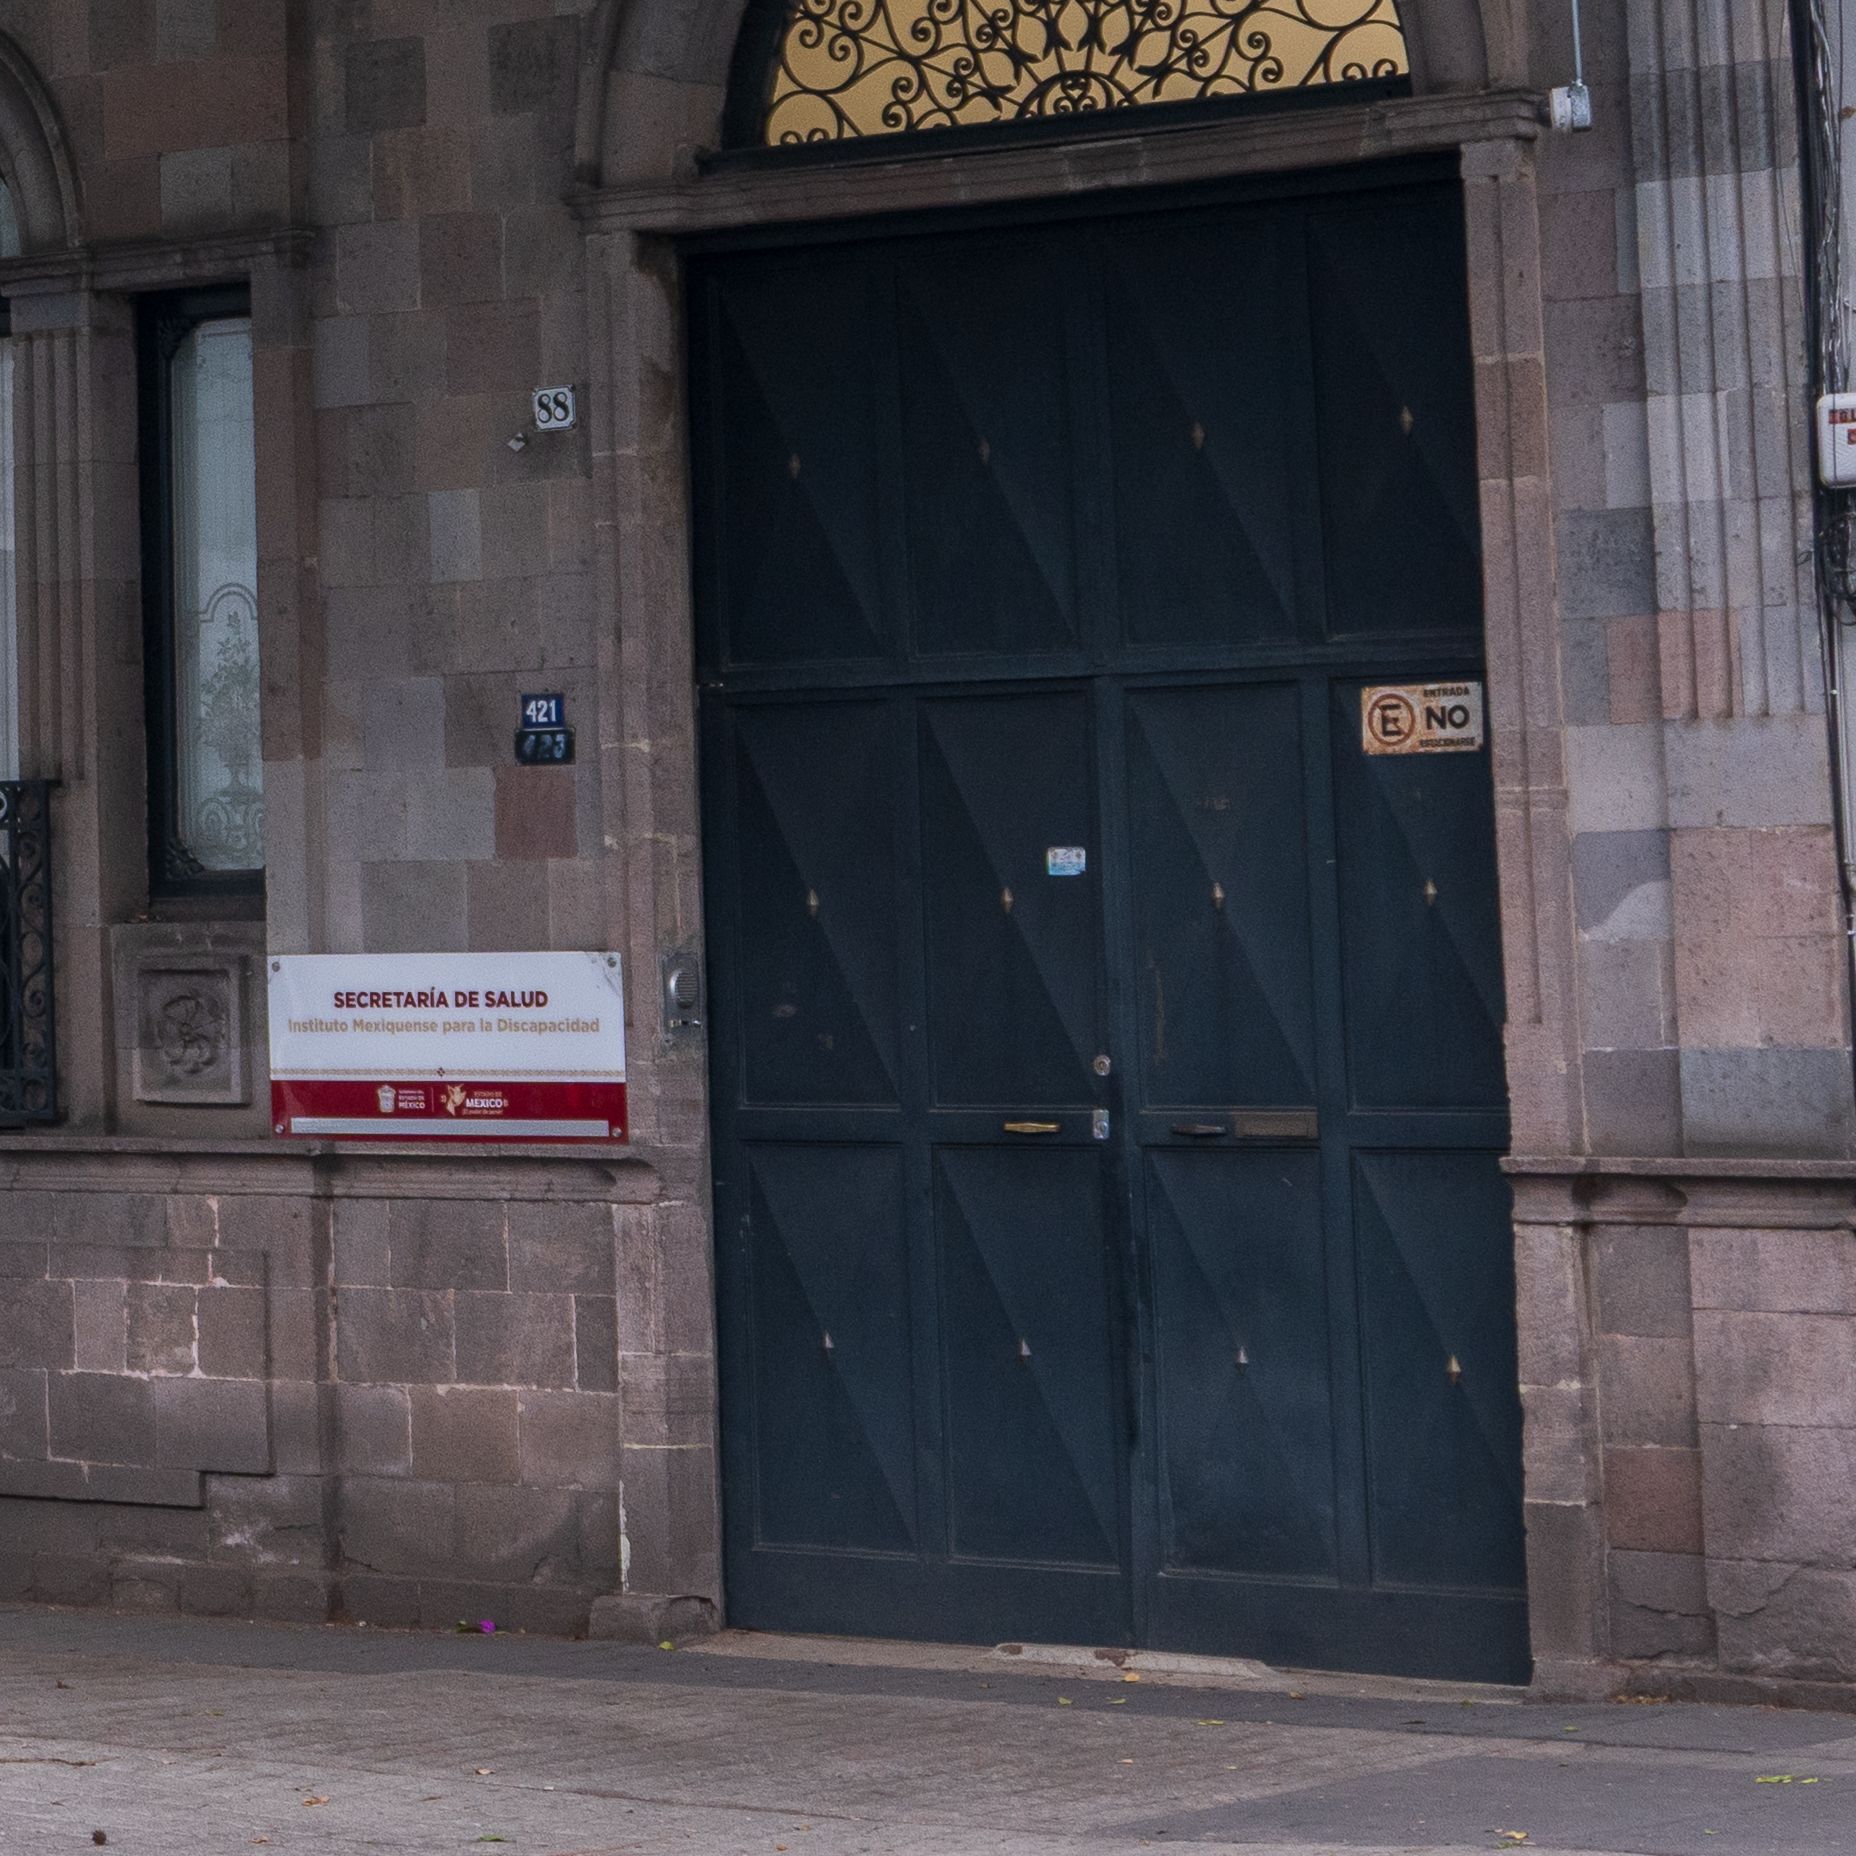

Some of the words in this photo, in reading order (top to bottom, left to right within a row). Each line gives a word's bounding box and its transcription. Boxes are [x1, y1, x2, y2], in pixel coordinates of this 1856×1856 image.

[1423, 686, 1470, 697] ENTRADA
[526, 699, 557, 723] 421
[1425, 704, 1470, 730] NO
[333, 986, 449, 1009] SECRETARÍA
[454, 991, 480, 1009] DE
[485, 990, 549, 1009] SALUD
[288, 1018, 348, 1033] Instituto
[353, 1018, 438, 1035] Mexiquense
[442, 1020, 476, 1035] para
[480, 1018, 493, 1033] la
[497, 1018, 600, 1035] Discapacidad
